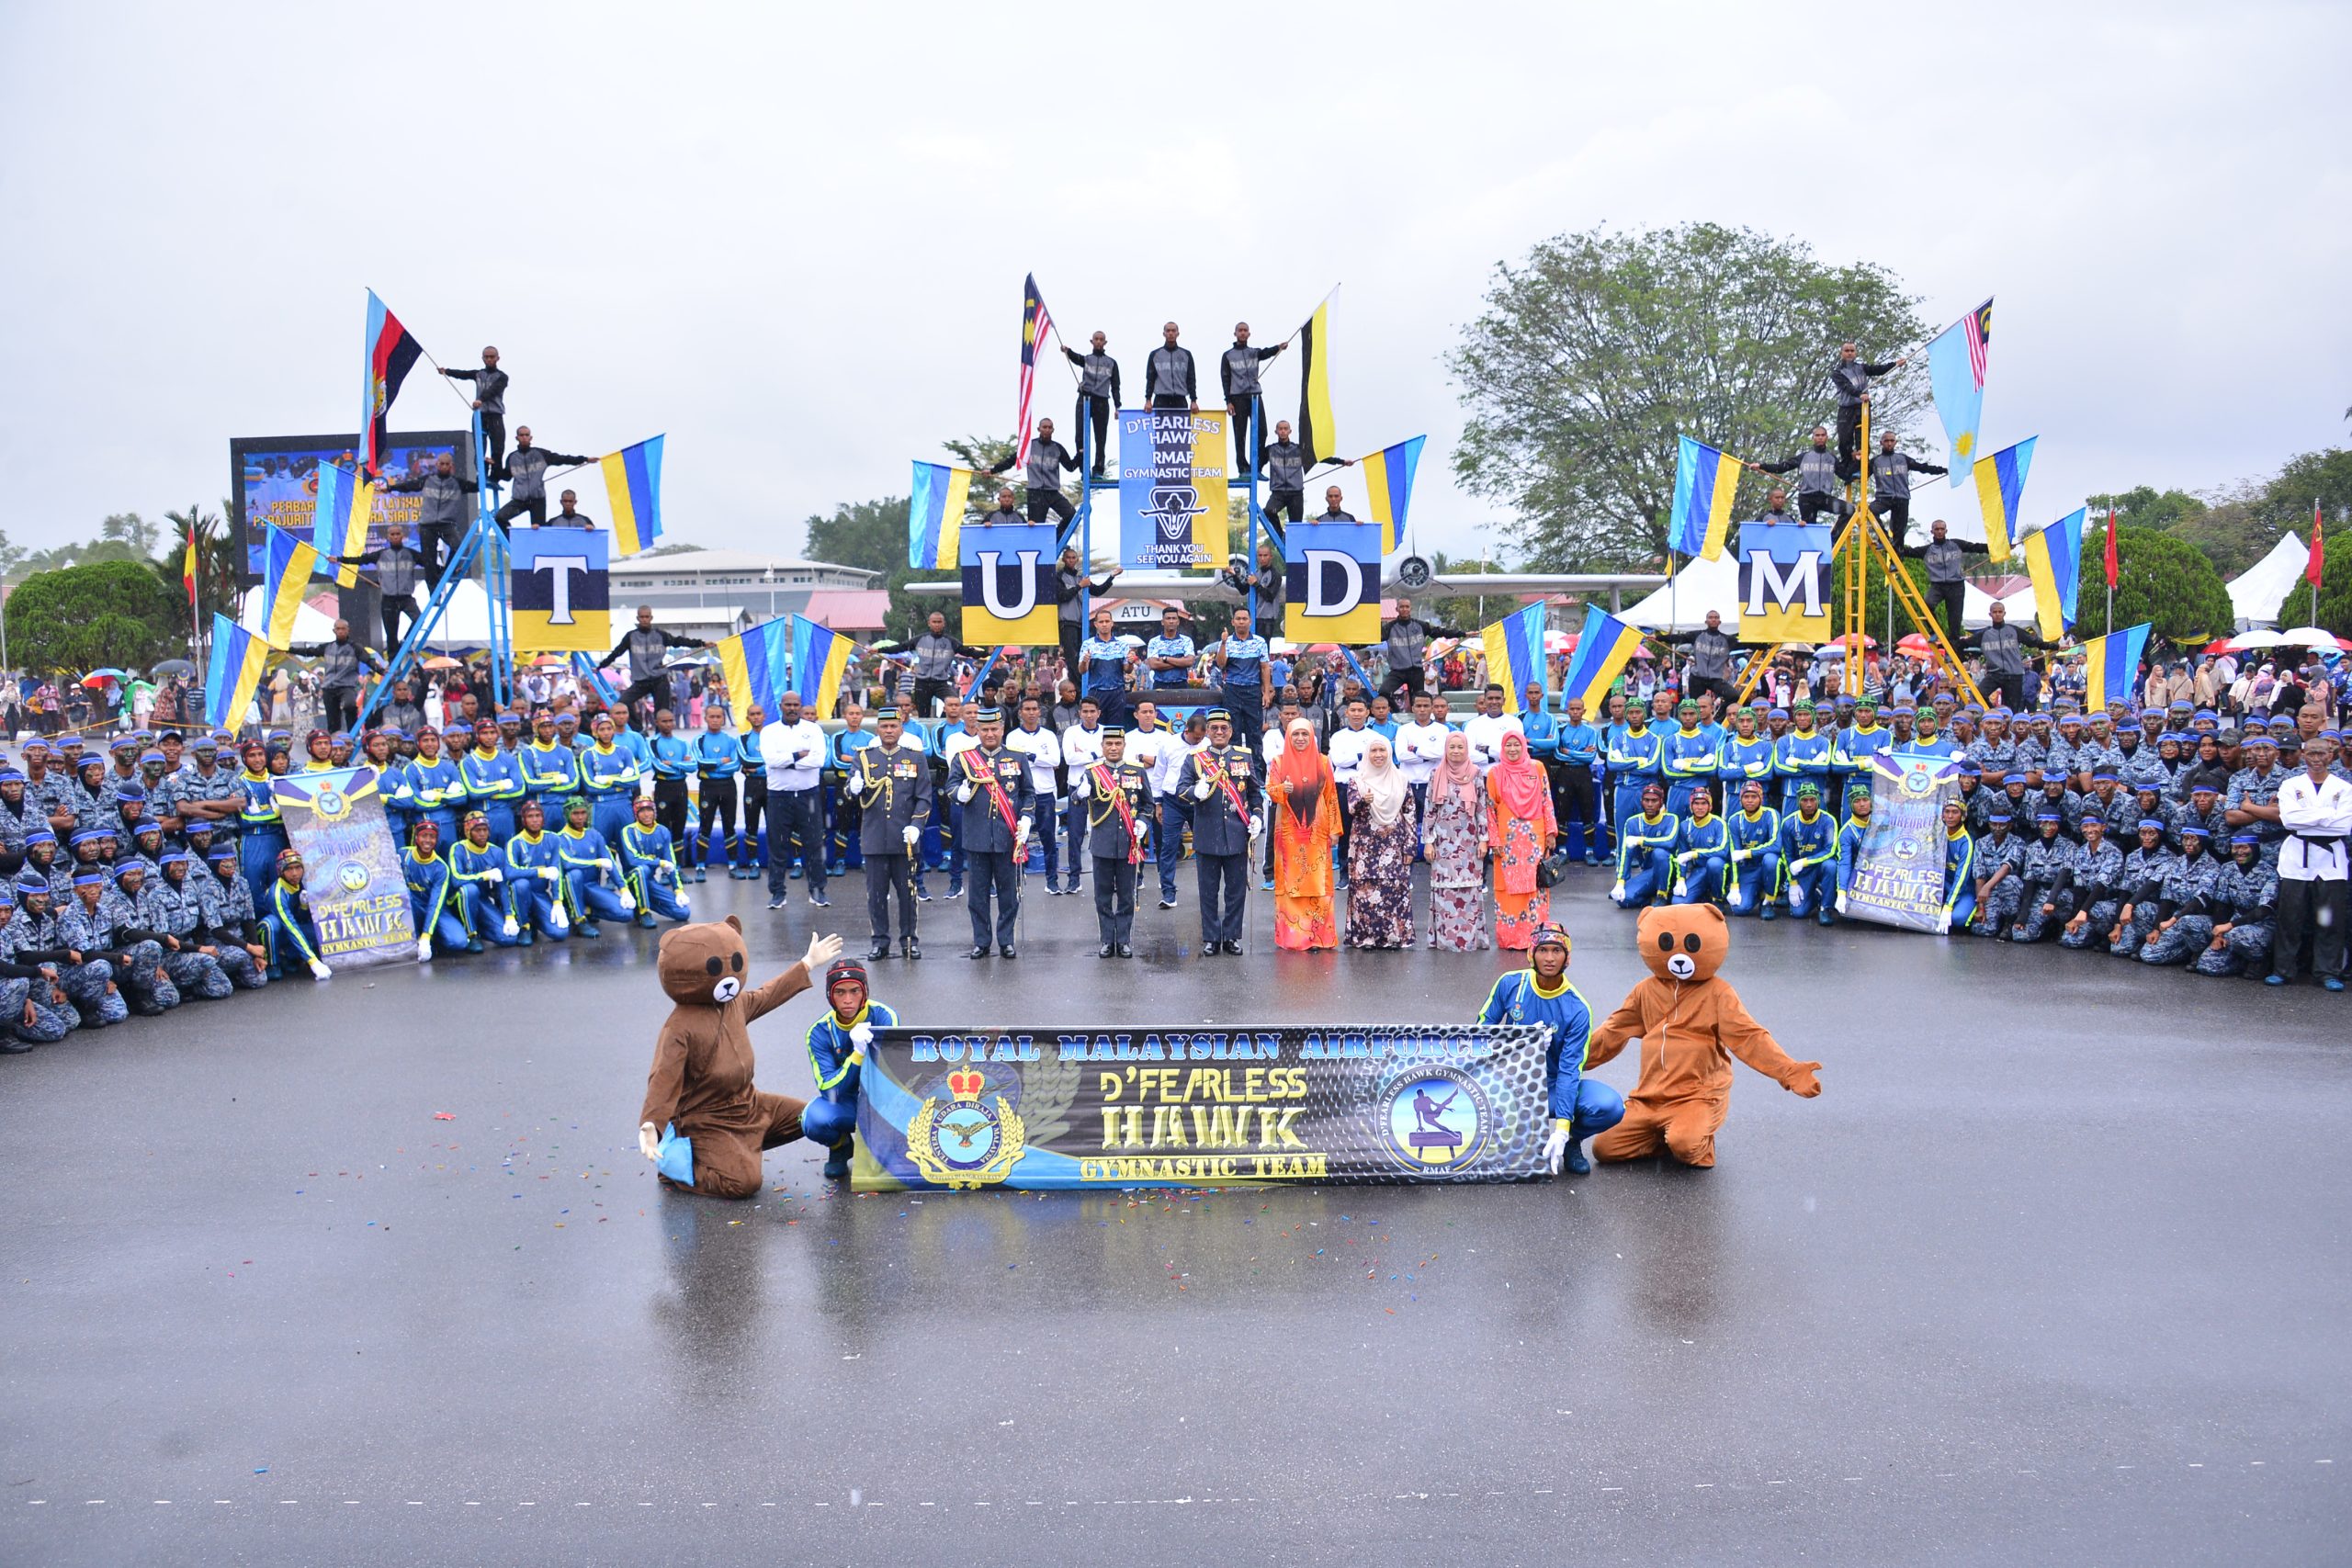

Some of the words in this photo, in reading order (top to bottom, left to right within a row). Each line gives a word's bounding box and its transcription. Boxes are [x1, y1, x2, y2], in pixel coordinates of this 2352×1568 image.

[1125, 416, 1221, 434] D'FEARLESS
[1148, 431, 1199, 445] HAWK
[1152, 451, 1194, 464] RMAF
[1804, 462, 1835, 472] RMAF
[1124, 468, 1190, 479] GYMNASTIC
[1191, 468, 1223, 479] TEAM
[271, 500, 317, 513] PERBAR
[388, 510, 409, 523] SIRI
[1145, 544, 1181, 554] THANK
[1181, 544, 1204, 553] YOU
[1136, 554, 1155, 564] SEE
[1156, 554, 1179, 564] YOU
[1180, 554, 1212, 563] AGAIN
[533, 555, 588, 625] T
[977, 550, 1042, 620] U
[1301, 548, 1363, 617] D
[1744, 548, 1826, 617] M
[1121, 605, 1151, 618] ATU
[1393, 635, 1423, 647] RMAF
[1984, 639, 2016, 651] RMAF
[339, 837, 368, 856] FORCE
[1854, 871, 1943, 906] HAWK
[318, 893, 403, 919] D'FEARLESS
[319, 909, 407, 942] HAWK
[910, 1035, 1042, 1063] ROYAL
[1057, 1033, 1283, 1061] MALAYSIAN
[1299, 1032, 1494, 1059] AIRFORCE
[1100, 1066, 1308, 1102] D'FEARLESS
[966, 1101, 993, 1120] DIRAJA
[1380, 1080, 1404, 1136] D'FEARLESS
[1403, 1068, 1433, 1085] HAWK
[1435, 1068, 1483, 1104] GYMNASTIC
[1479, 1104, 1488, 1134] TEAM
[937, 1102, 963, 1122] UDARA
[1101, 1105, 1309, 1150] HAWK
[931, 1130, 949, 1165] TENTERA
[980, 1127, 1001, 1165] MALAYSIA
[1080, 1157, 1238, 1179] GYMNASTIC
[1251, 1156, 1327, 1177] TEAM
[1422, 1165, 1452, 1175] RMAF
